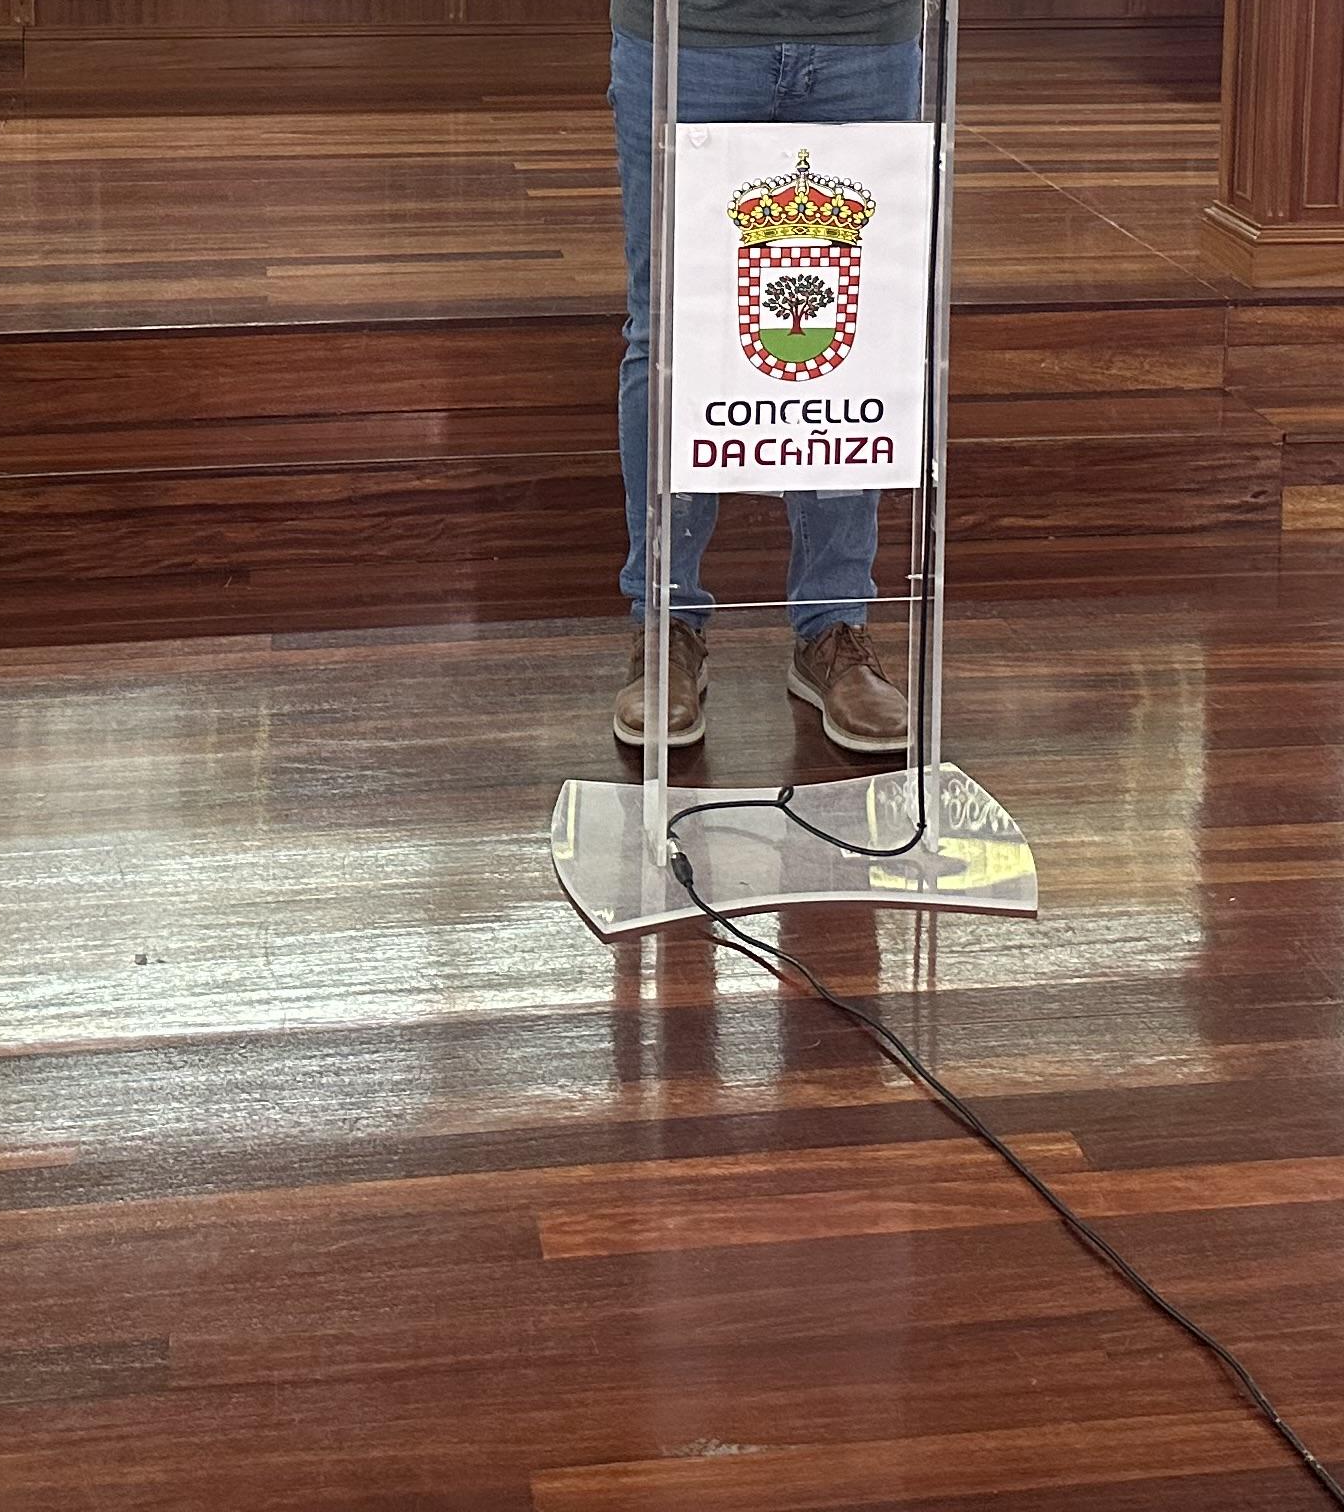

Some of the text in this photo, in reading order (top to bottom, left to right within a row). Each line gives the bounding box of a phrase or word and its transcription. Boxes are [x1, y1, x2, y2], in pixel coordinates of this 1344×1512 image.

[705, 398, 885, 426] CONCELLO
[692, 429, 894, 468] DA CAÑIZA
